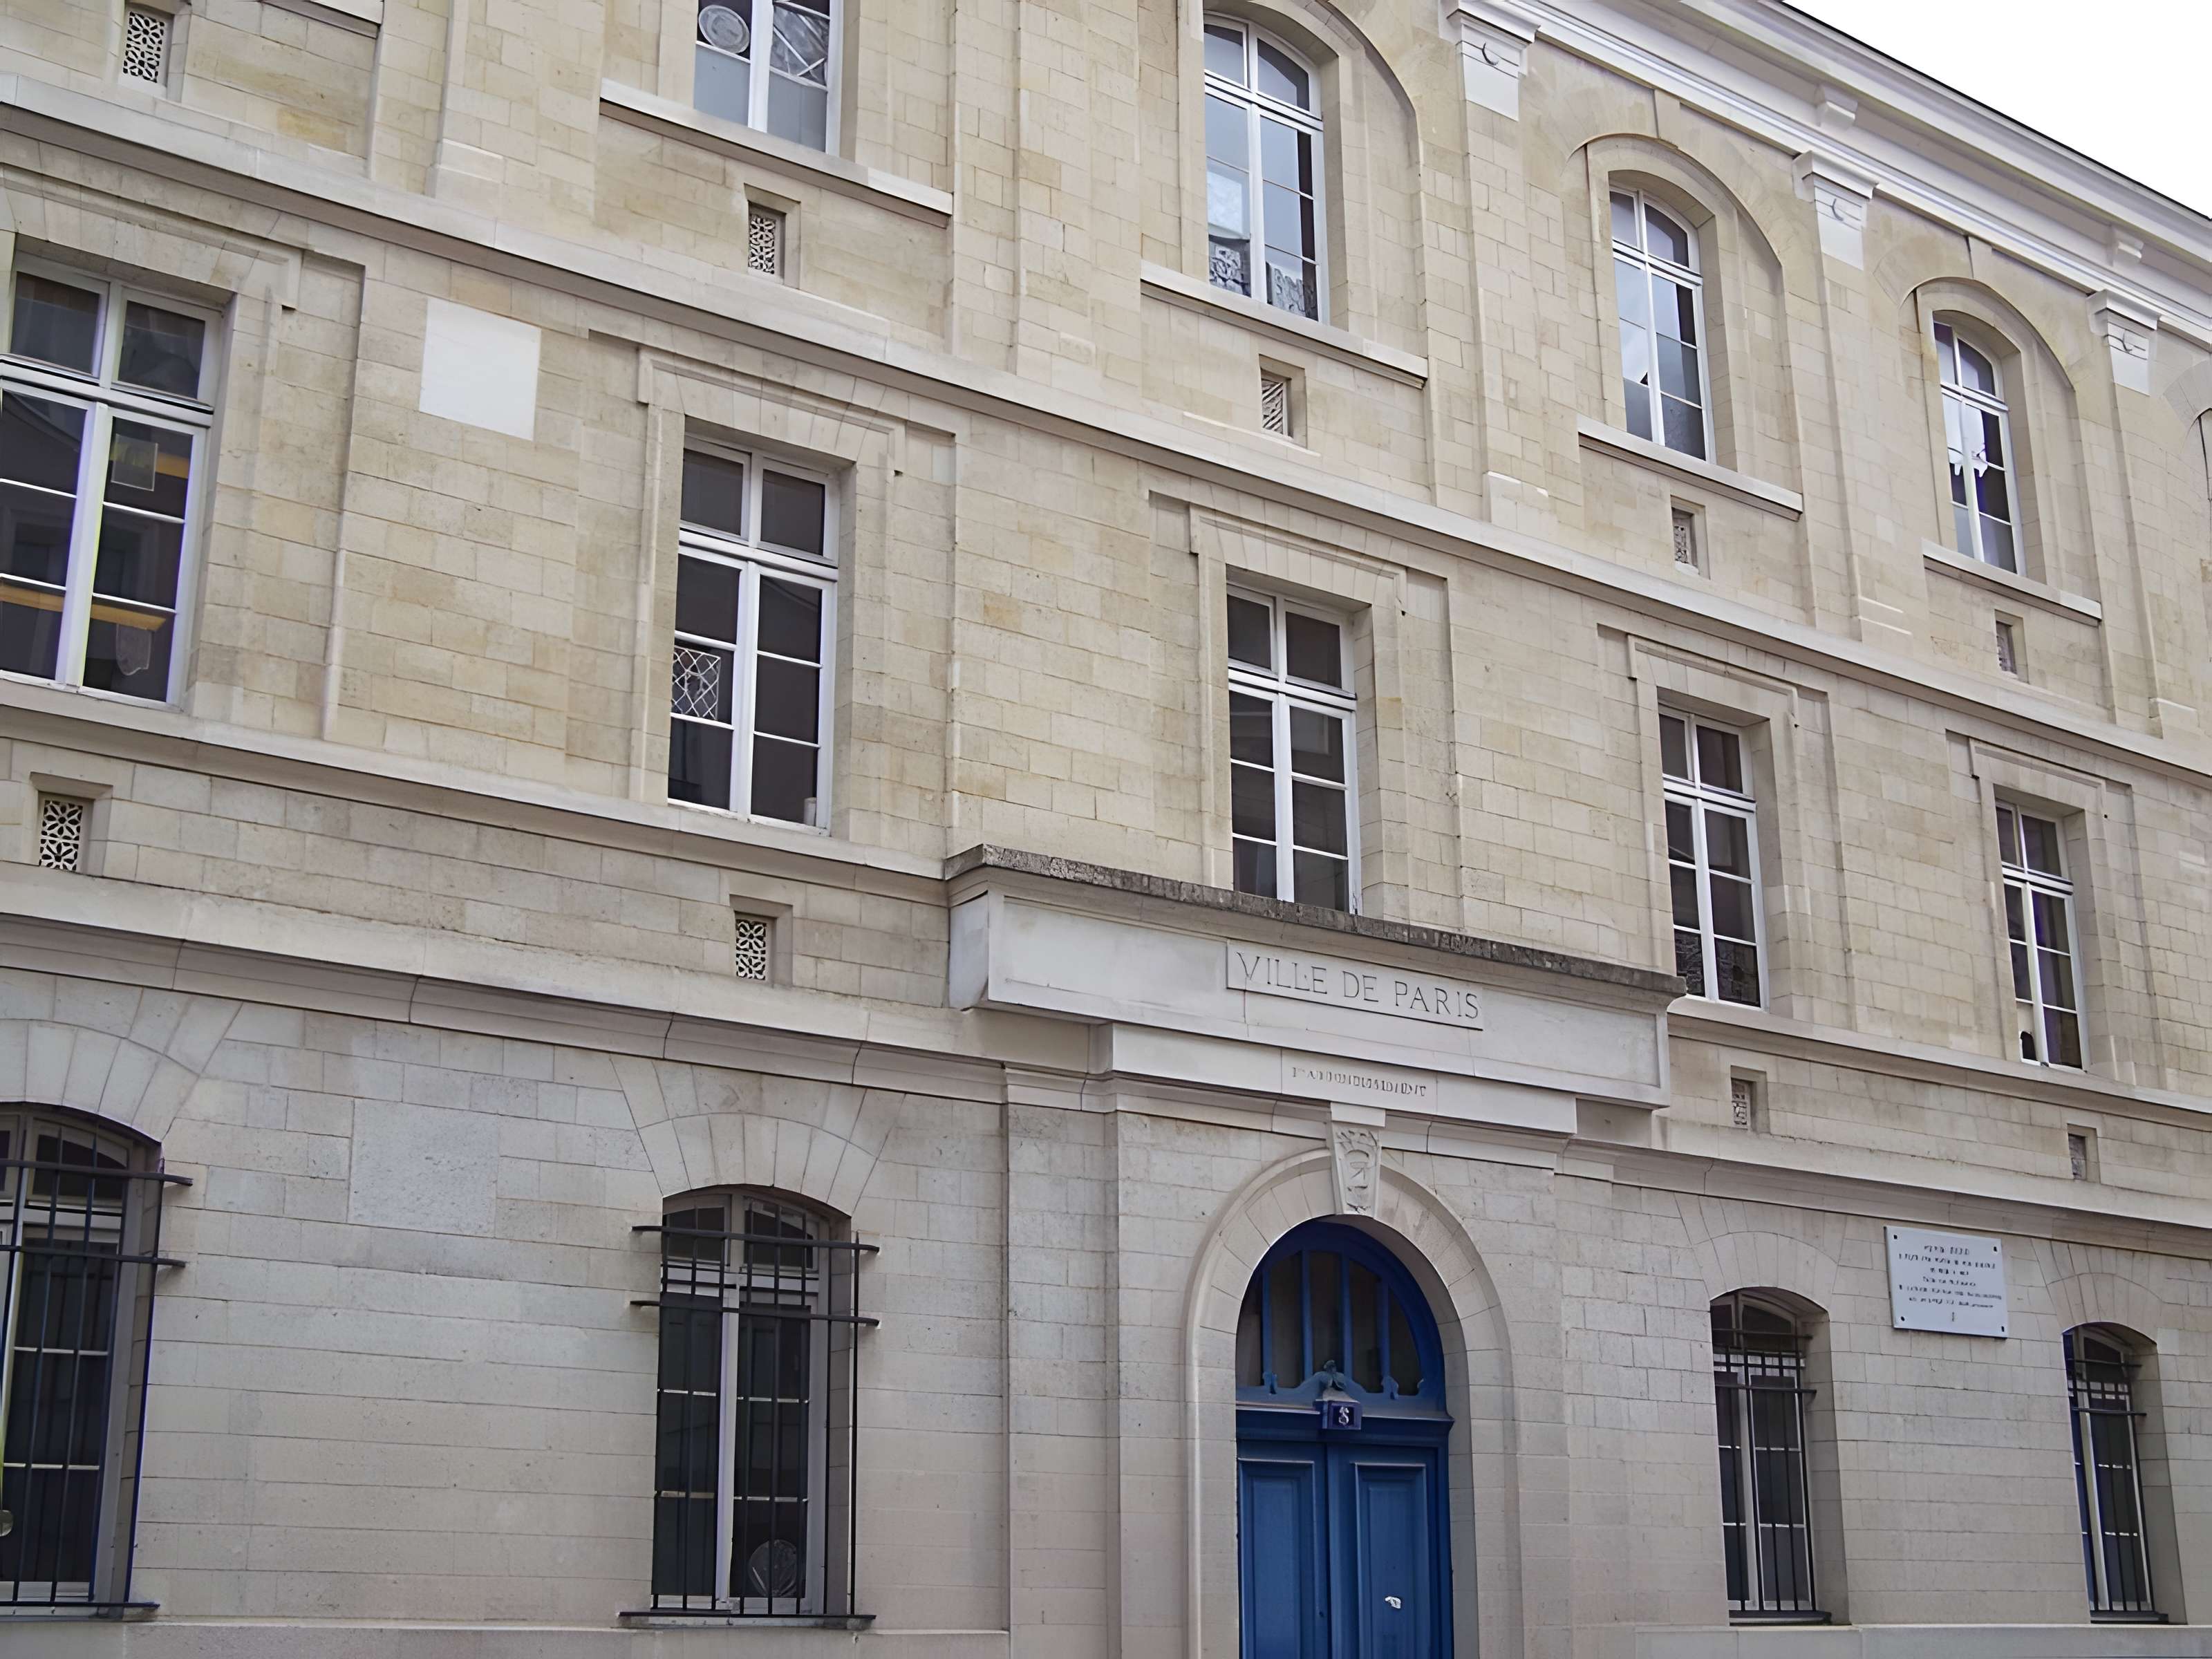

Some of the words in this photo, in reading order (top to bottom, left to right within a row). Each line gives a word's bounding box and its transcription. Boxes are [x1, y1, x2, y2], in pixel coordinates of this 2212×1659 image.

[1236, 951, 1328, 995] VILLE
[1342, 970, 1380, 1003] DE
[1394, 980, 1479, 1020] PARIS
